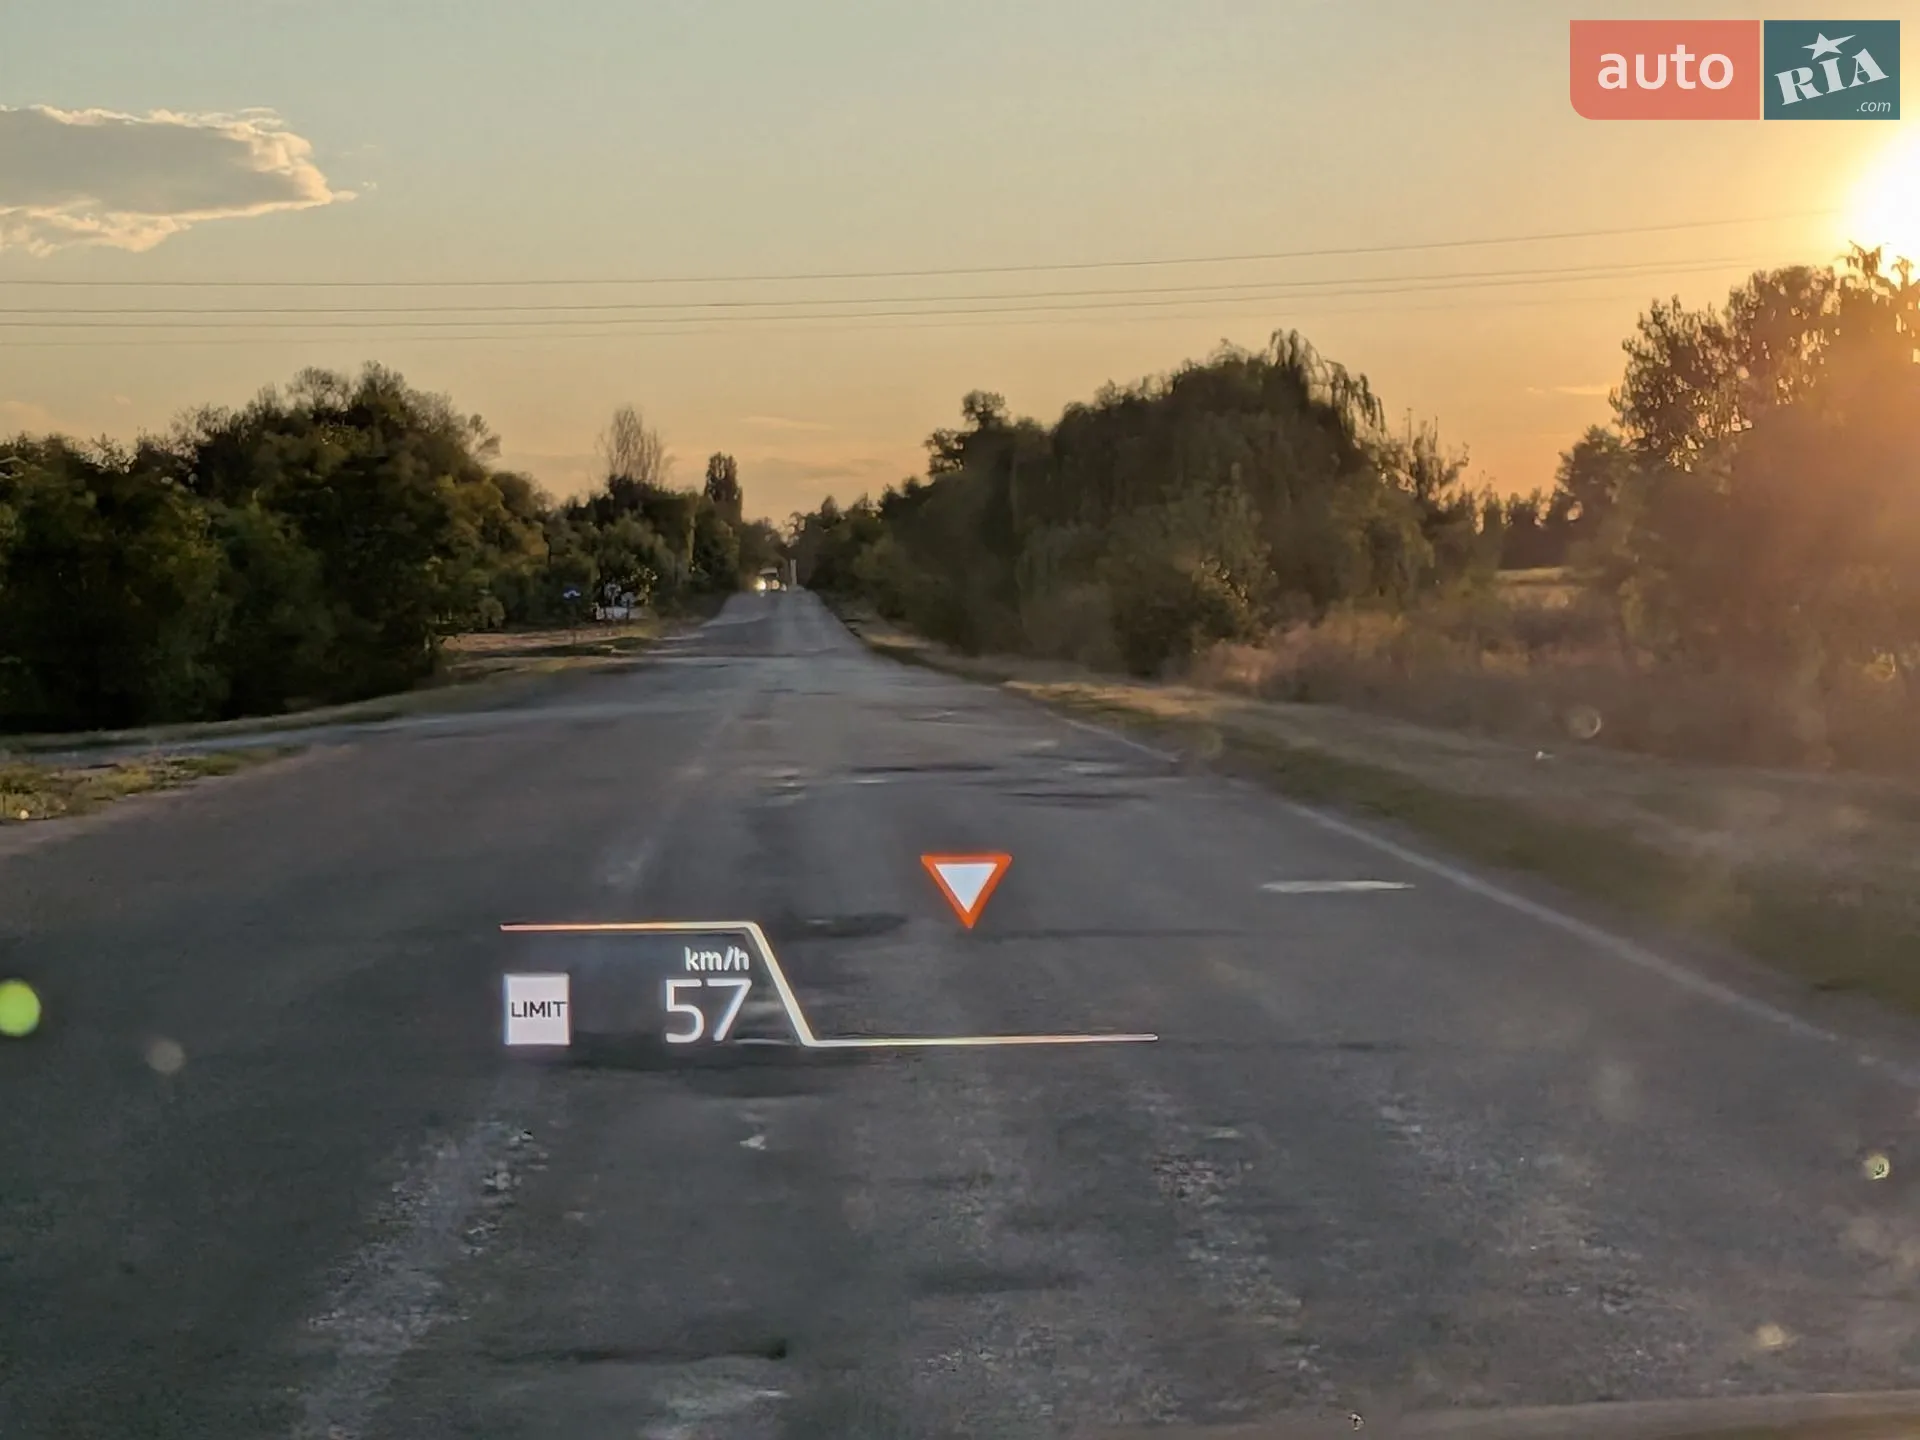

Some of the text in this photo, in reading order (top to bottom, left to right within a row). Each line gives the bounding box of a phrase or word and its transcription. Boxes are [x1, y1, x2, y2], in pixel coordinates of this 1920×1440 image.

[684, 946, 750, 971] km/h
[511, 1000, 568, 1019] LIMIT
[665, 979, 752, 1043] 57
